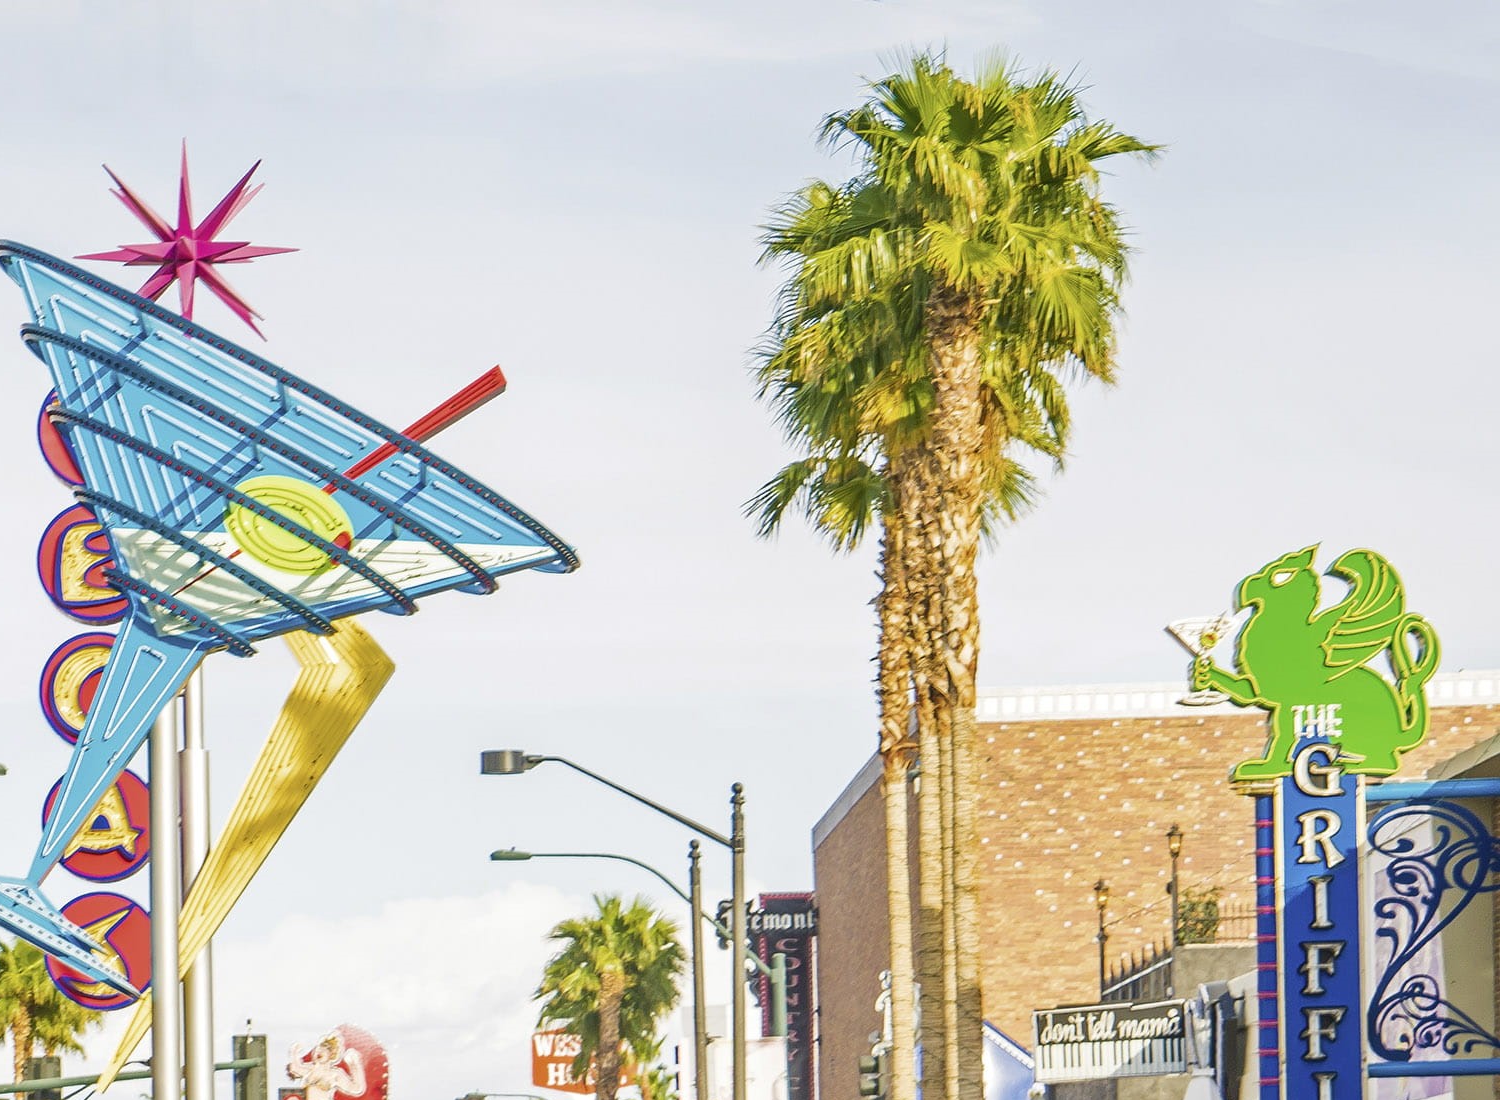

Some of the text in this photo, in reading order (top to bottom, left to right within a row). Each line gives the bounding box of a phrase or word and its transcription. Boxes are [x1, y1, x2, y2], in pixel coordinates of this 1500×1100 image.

[1292, 704, 1342, 738] THE
[1086, 1010, 1117, 1042] tell
[1117, 1008, 1182, 1039] mama
